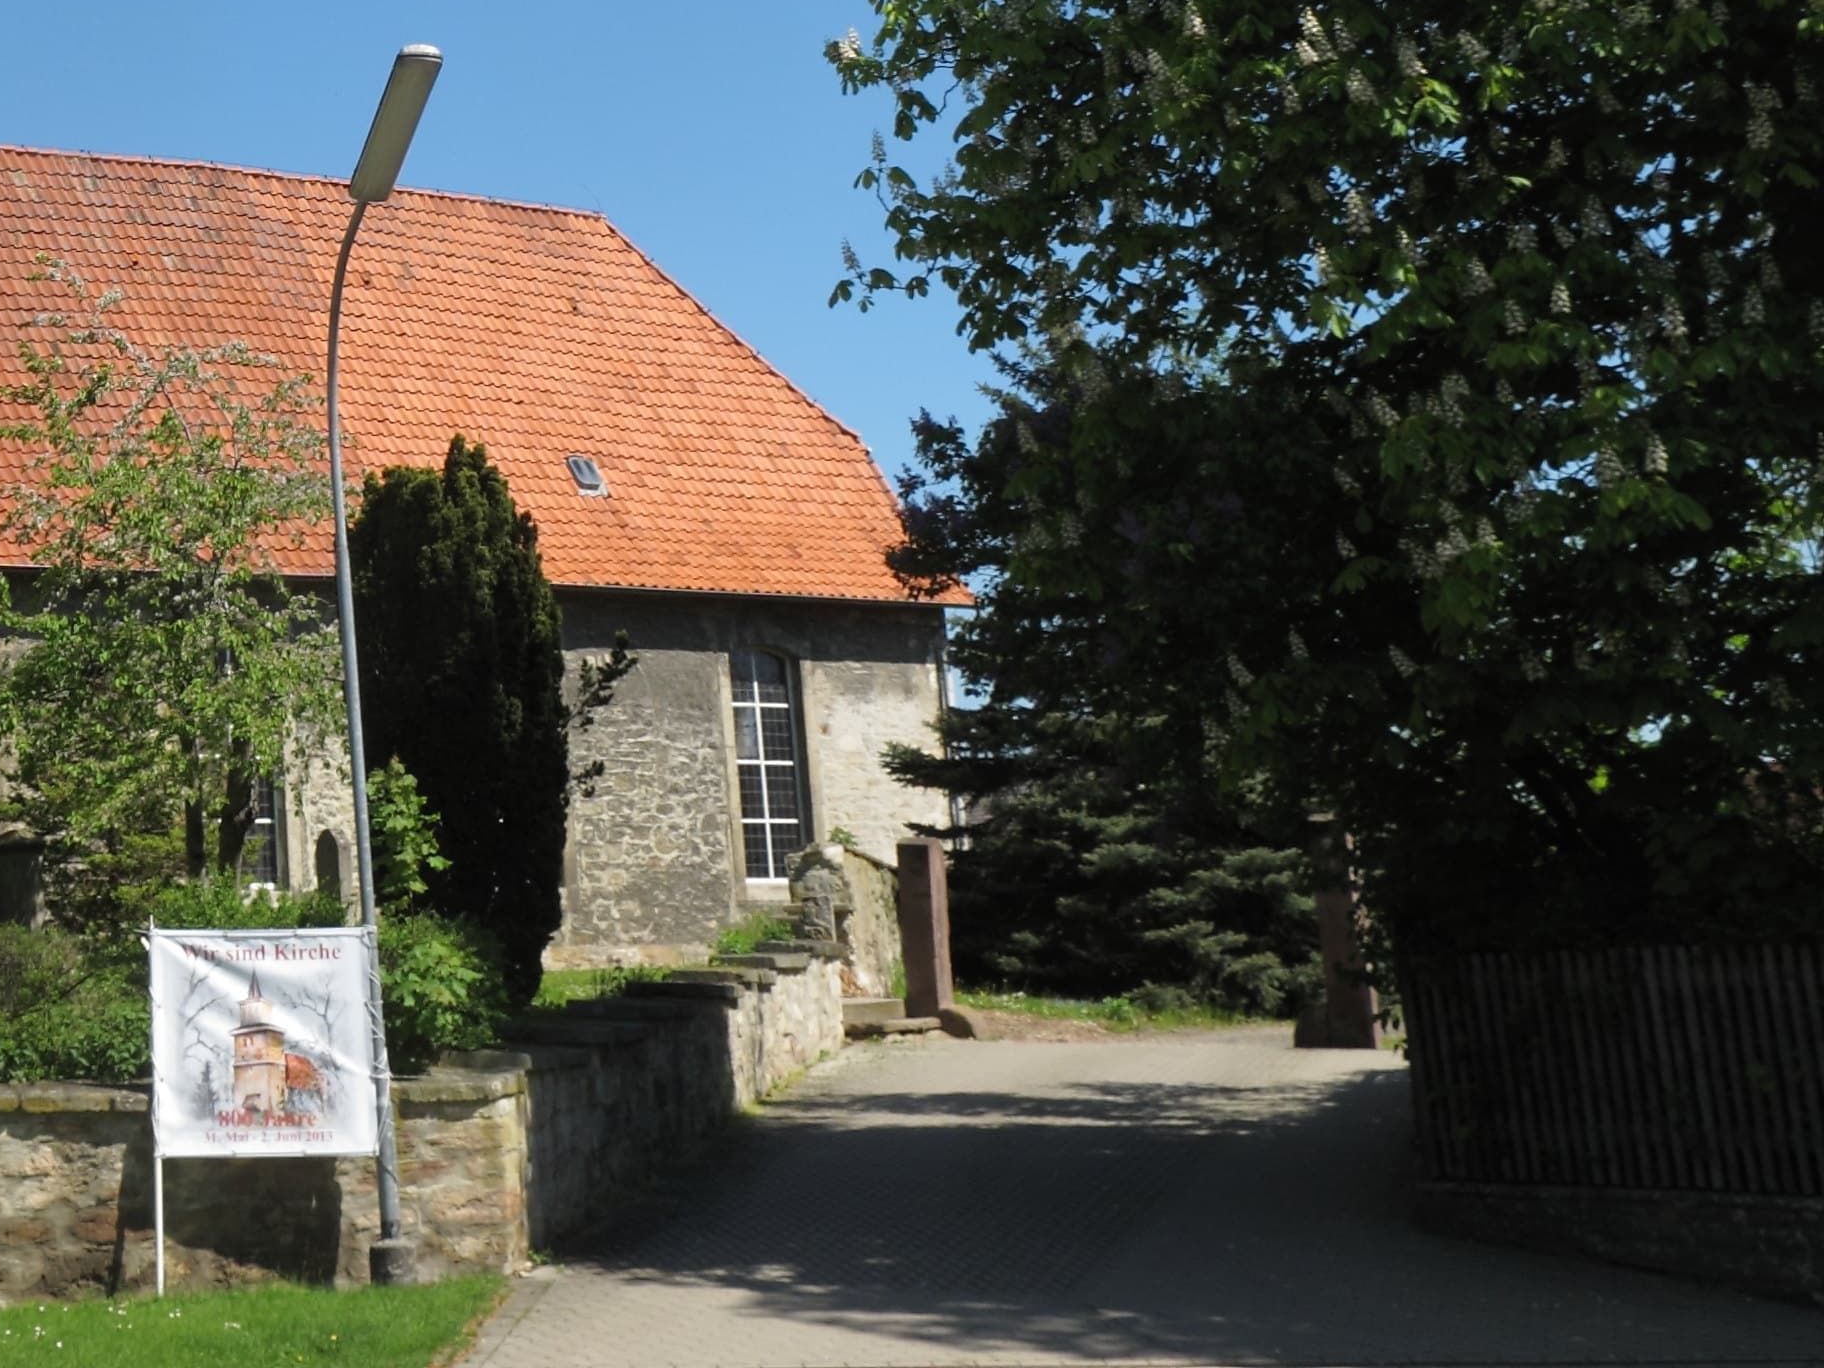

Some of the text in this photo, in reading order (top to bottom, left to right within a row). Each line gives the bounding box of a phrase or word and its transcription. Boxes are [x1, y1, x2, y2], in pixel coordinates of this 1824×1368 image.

[182, 943, 342, 960] Wir sind Kirche
[218, 1110, 317, 1127] 800 Jahre
[226, 1131, 249, 1143] Mai
[275, 1131, 301, 1143] Juni
